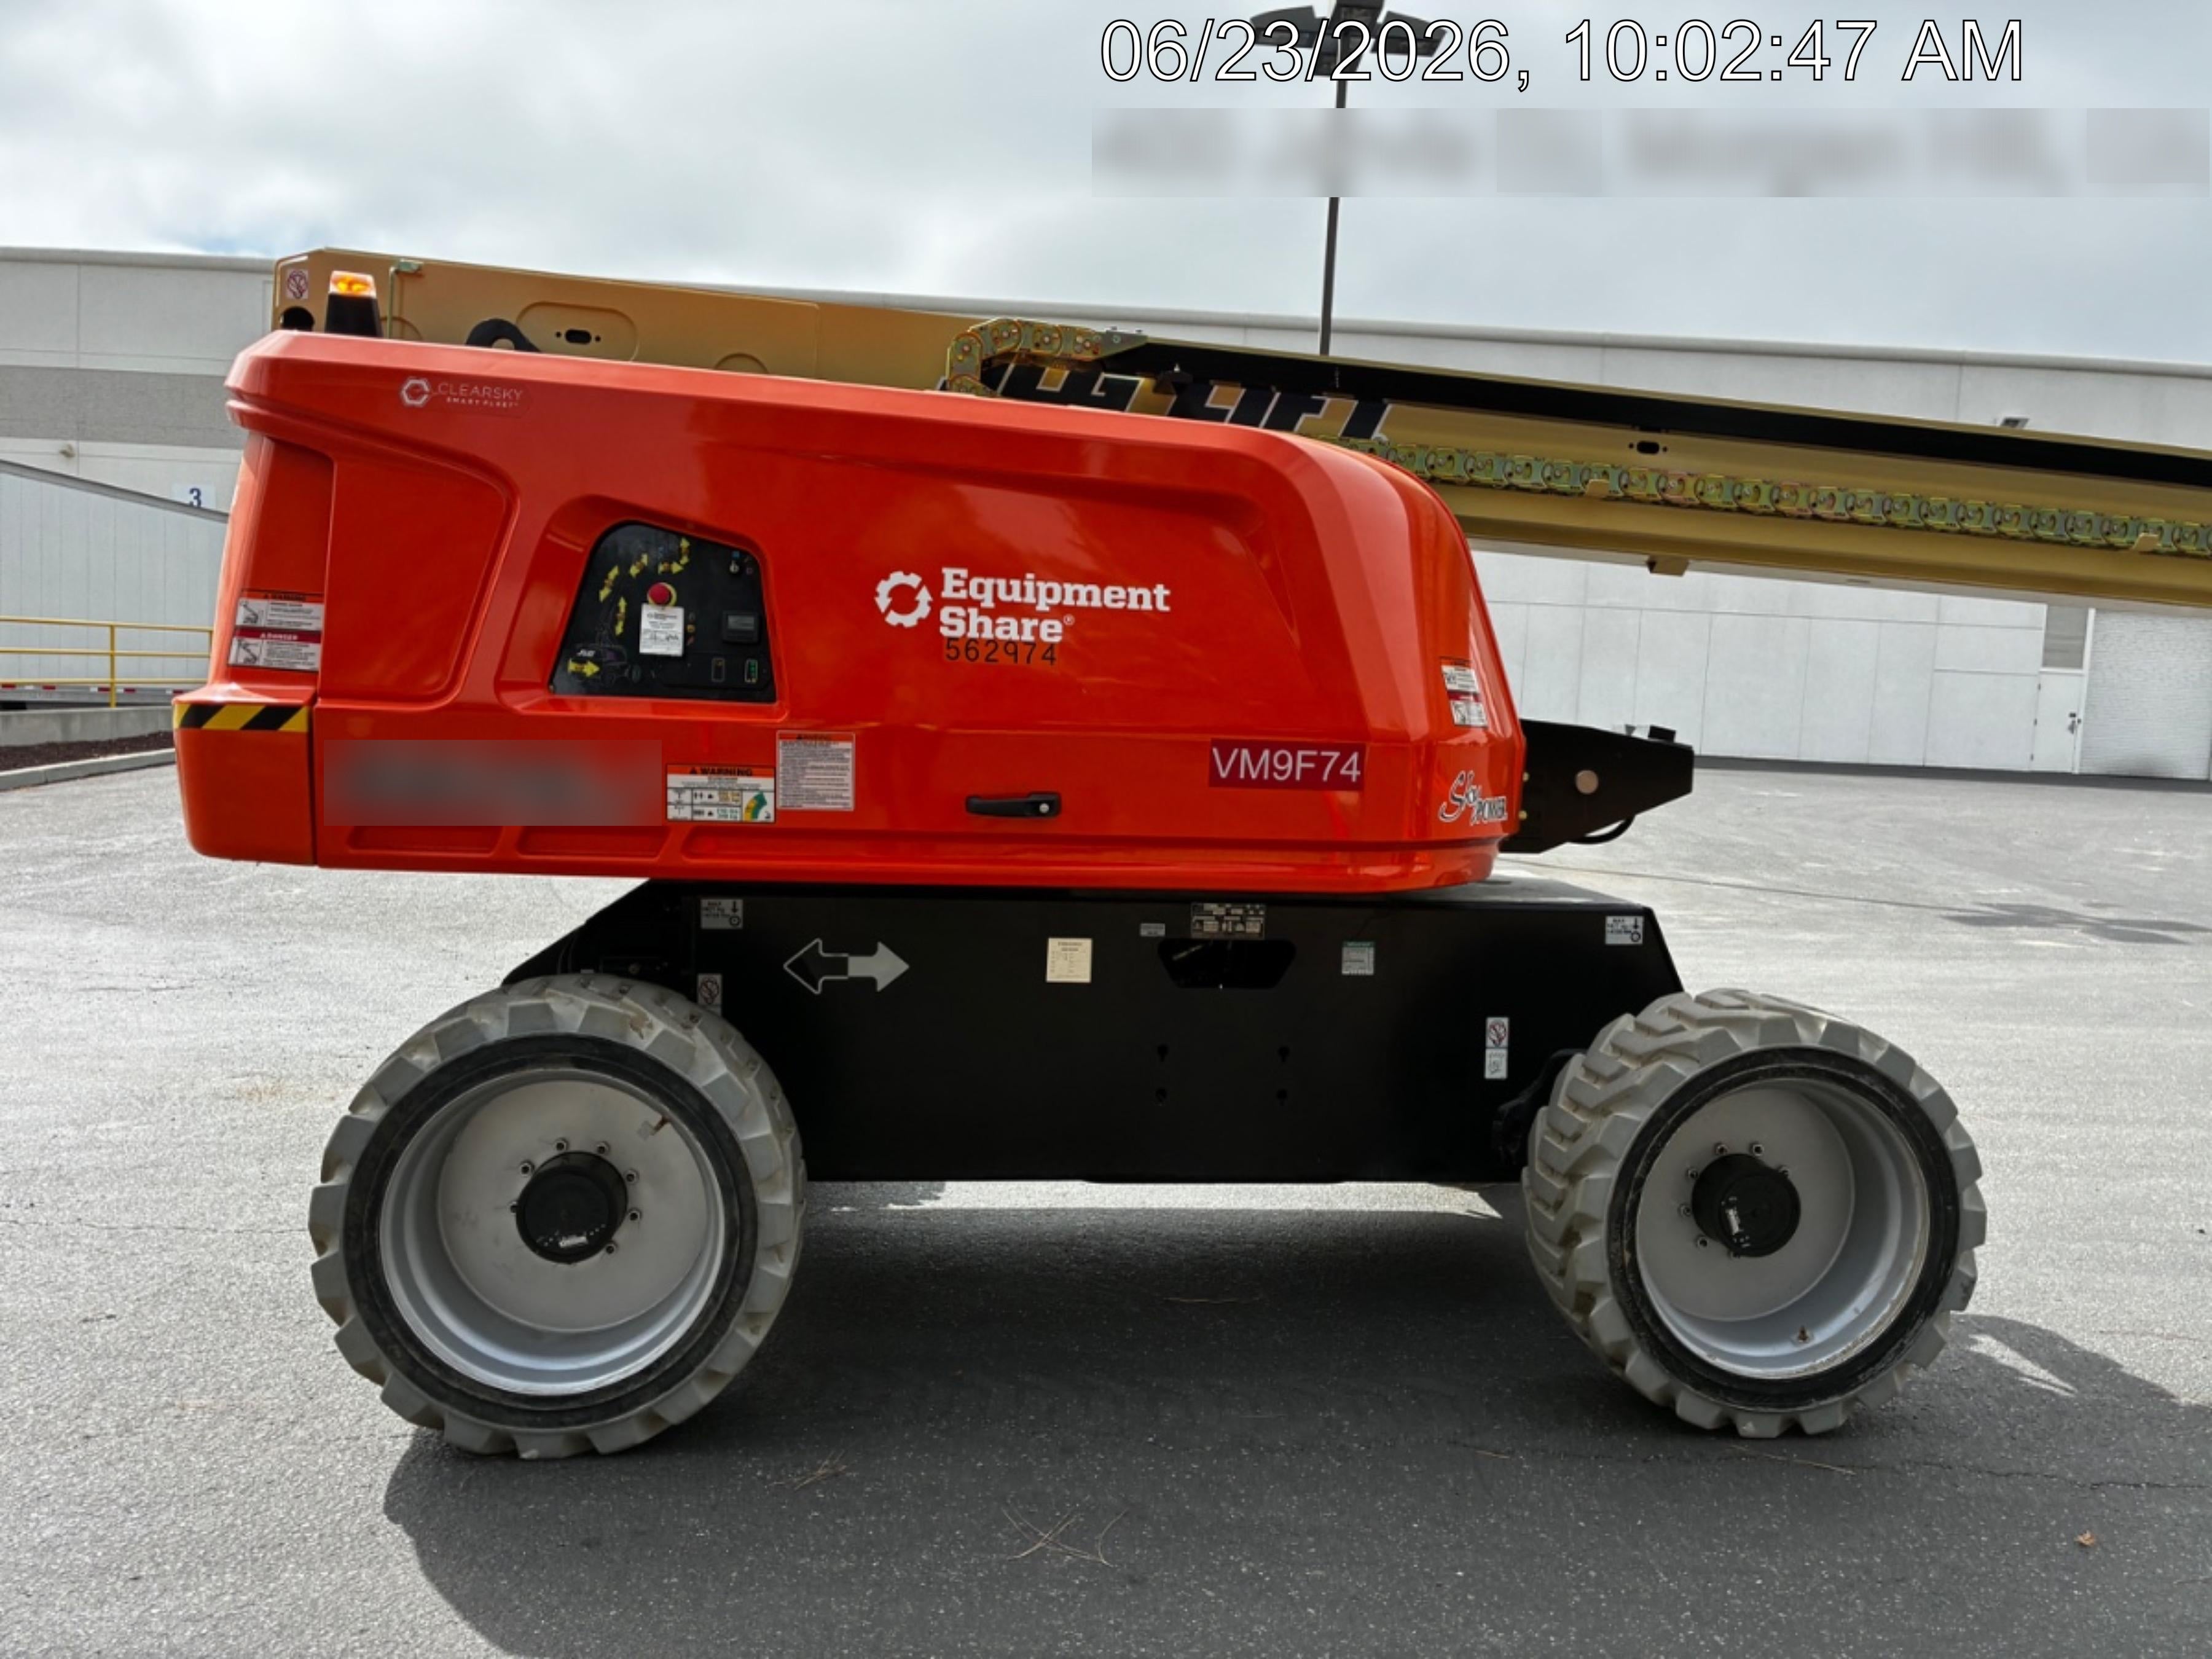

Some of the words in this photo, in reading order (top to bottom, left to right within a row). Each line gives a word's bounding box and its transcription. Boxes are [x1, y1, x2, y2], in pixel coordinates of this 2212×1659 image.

[437, 382, 522, 401] CLEARSKY
[189, 488, 202, 508] 3
[941, 567, 1171, 611] Equipment
[944, 638, 1057, 665] 562974
[1212, 747, 1361, 783] VM9F74
